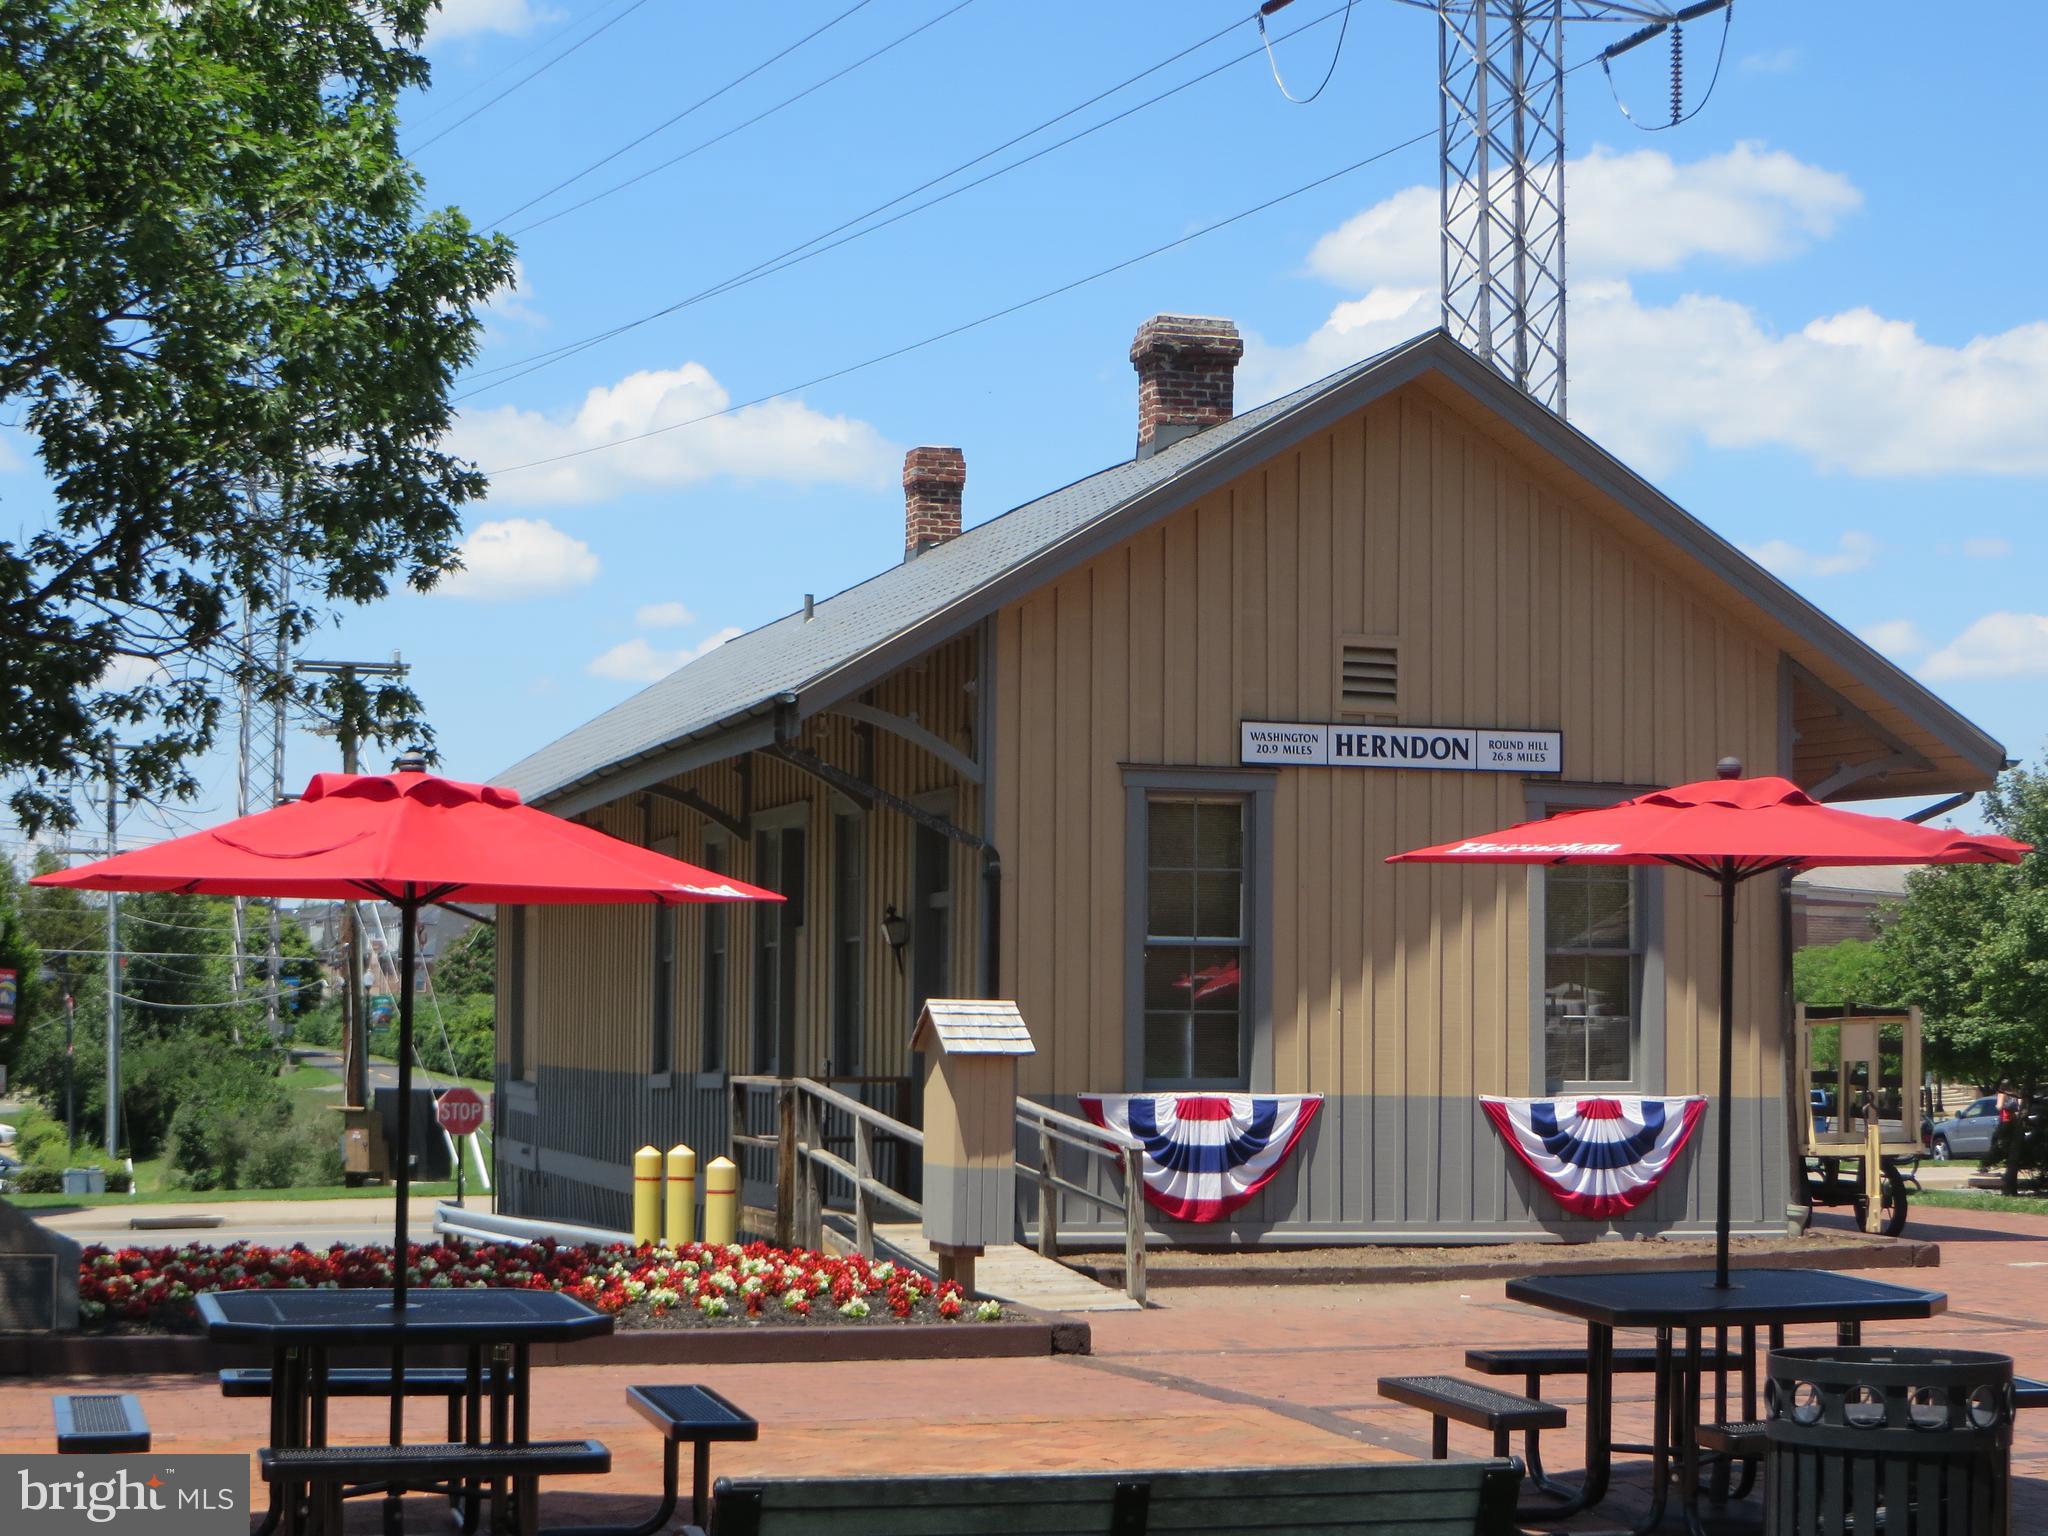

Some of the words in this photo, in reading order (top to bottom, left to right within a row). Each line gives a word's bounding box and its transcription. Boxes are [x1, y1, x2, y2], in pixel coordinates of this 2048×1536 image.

[1250, 732, 1319, 743] WASHINGTON
[1256, 744, 1278, 754] 20.9
[1282, 745, 1313, 755] MILES
[1335, 733, 1470, 760] HERNDON
[1488, 739, 1524, 750] ROUND
[1528, 741, 1549, 751] HILL
[1492, 751, 1513, 762] 26.8
[1516, 752, 1546, 763] MILES
[440, 1102, 481, 1120] STOP
